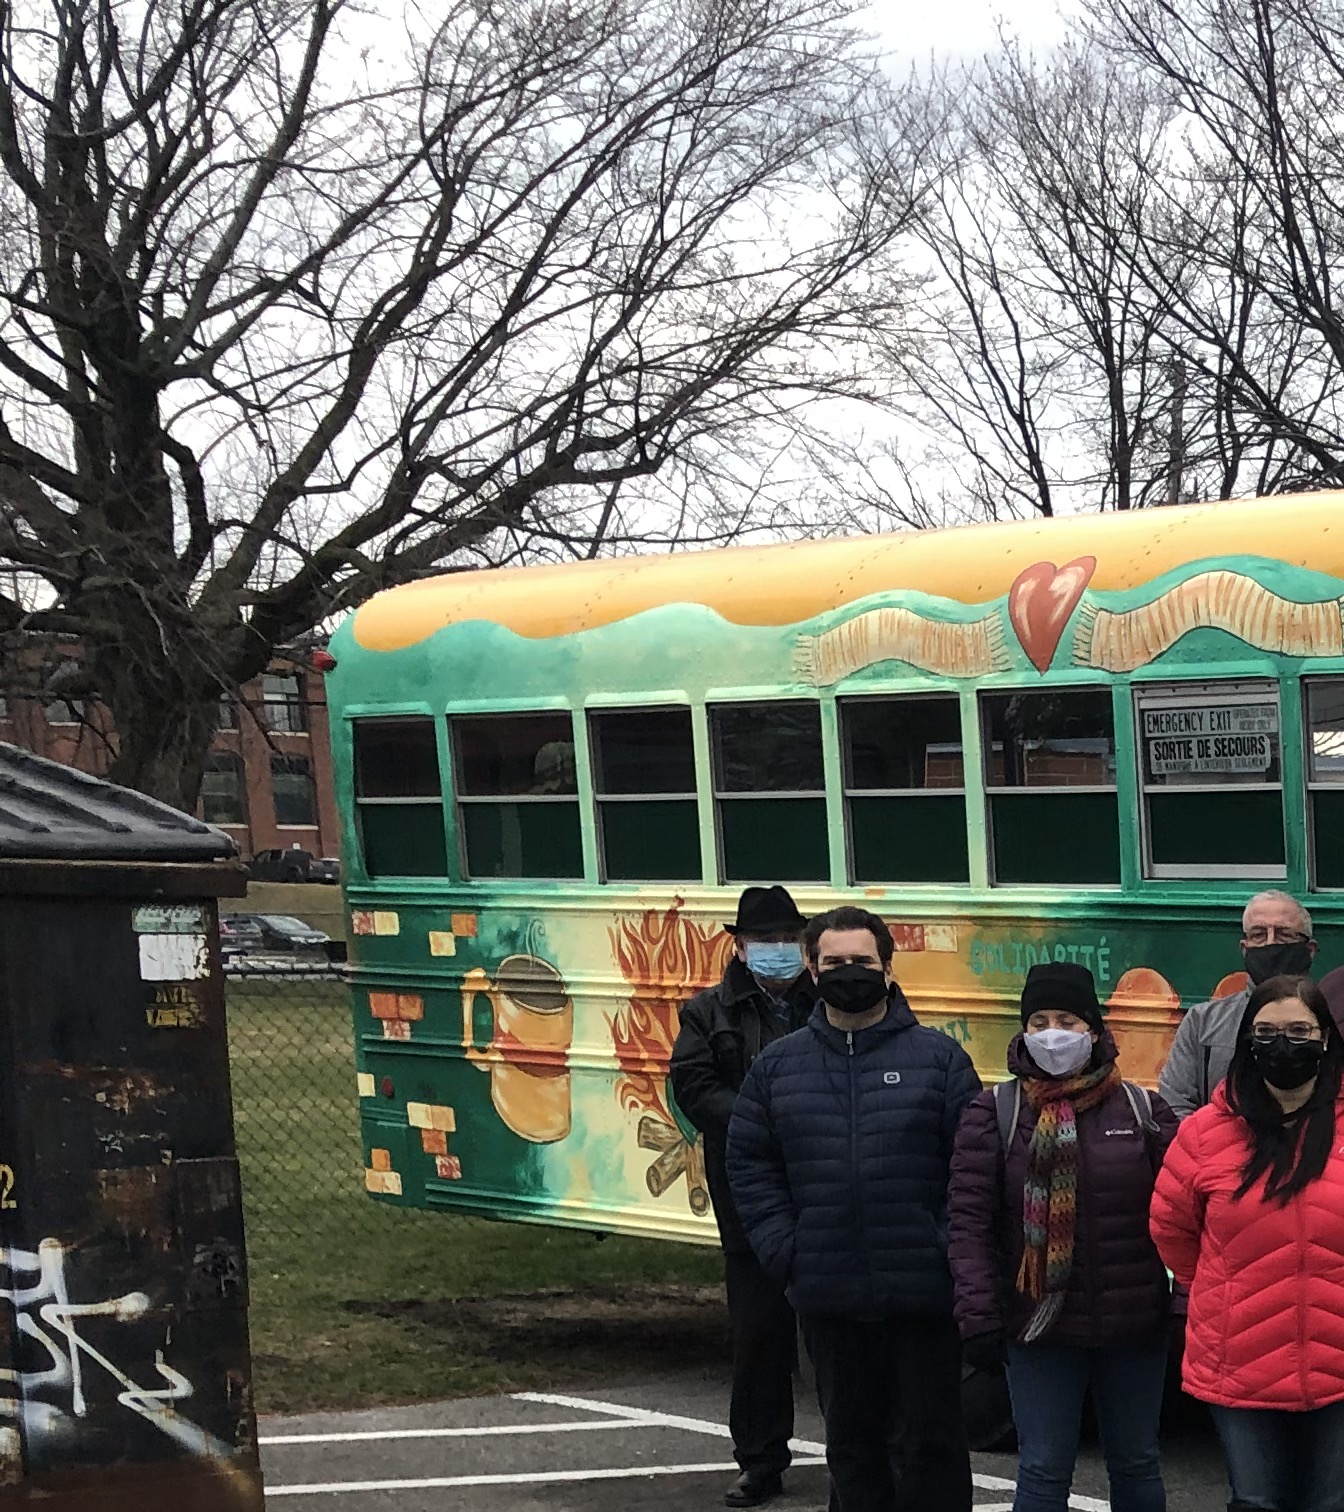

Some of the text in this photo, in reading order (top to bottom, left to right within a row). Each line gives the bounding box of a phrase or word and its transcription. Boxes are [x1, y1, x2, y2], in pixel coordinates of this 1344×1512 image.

[1146, 710, 1204, 734] EMERGENCY
[1209, 710, 1232, 732] EXIT
[1154, 736, 1266, 761] SORTIE DE SECOURS
